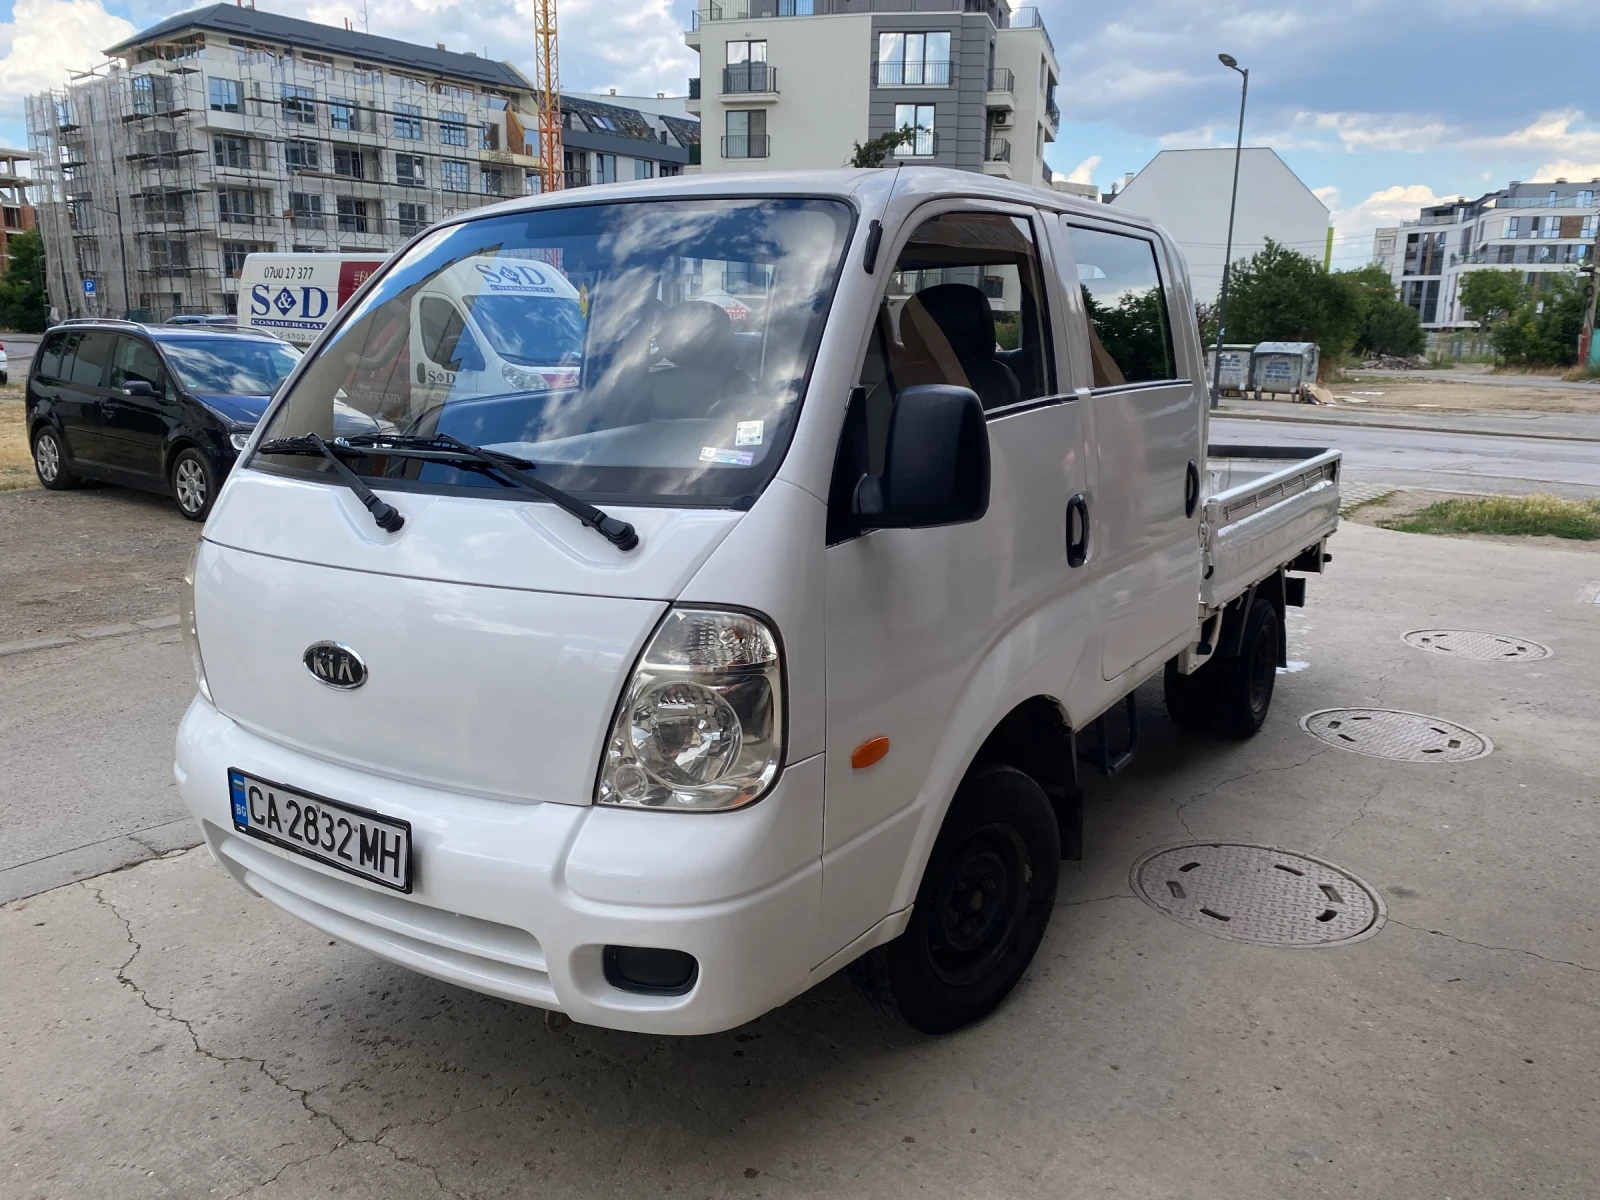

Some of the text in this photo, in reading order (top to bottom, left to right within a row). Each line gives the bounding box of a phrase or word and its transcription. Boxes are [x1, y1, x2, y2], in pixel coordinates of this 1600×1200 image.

[264, 266, 314, 280] 0700 17 377
[475, 264, 546, 286] S&D
[86, 281, 93, 291] P
[251, 284, 329, 319] S&D
[312, 649, 355, 682] KIA
[236, 803, 247, 817] BG
